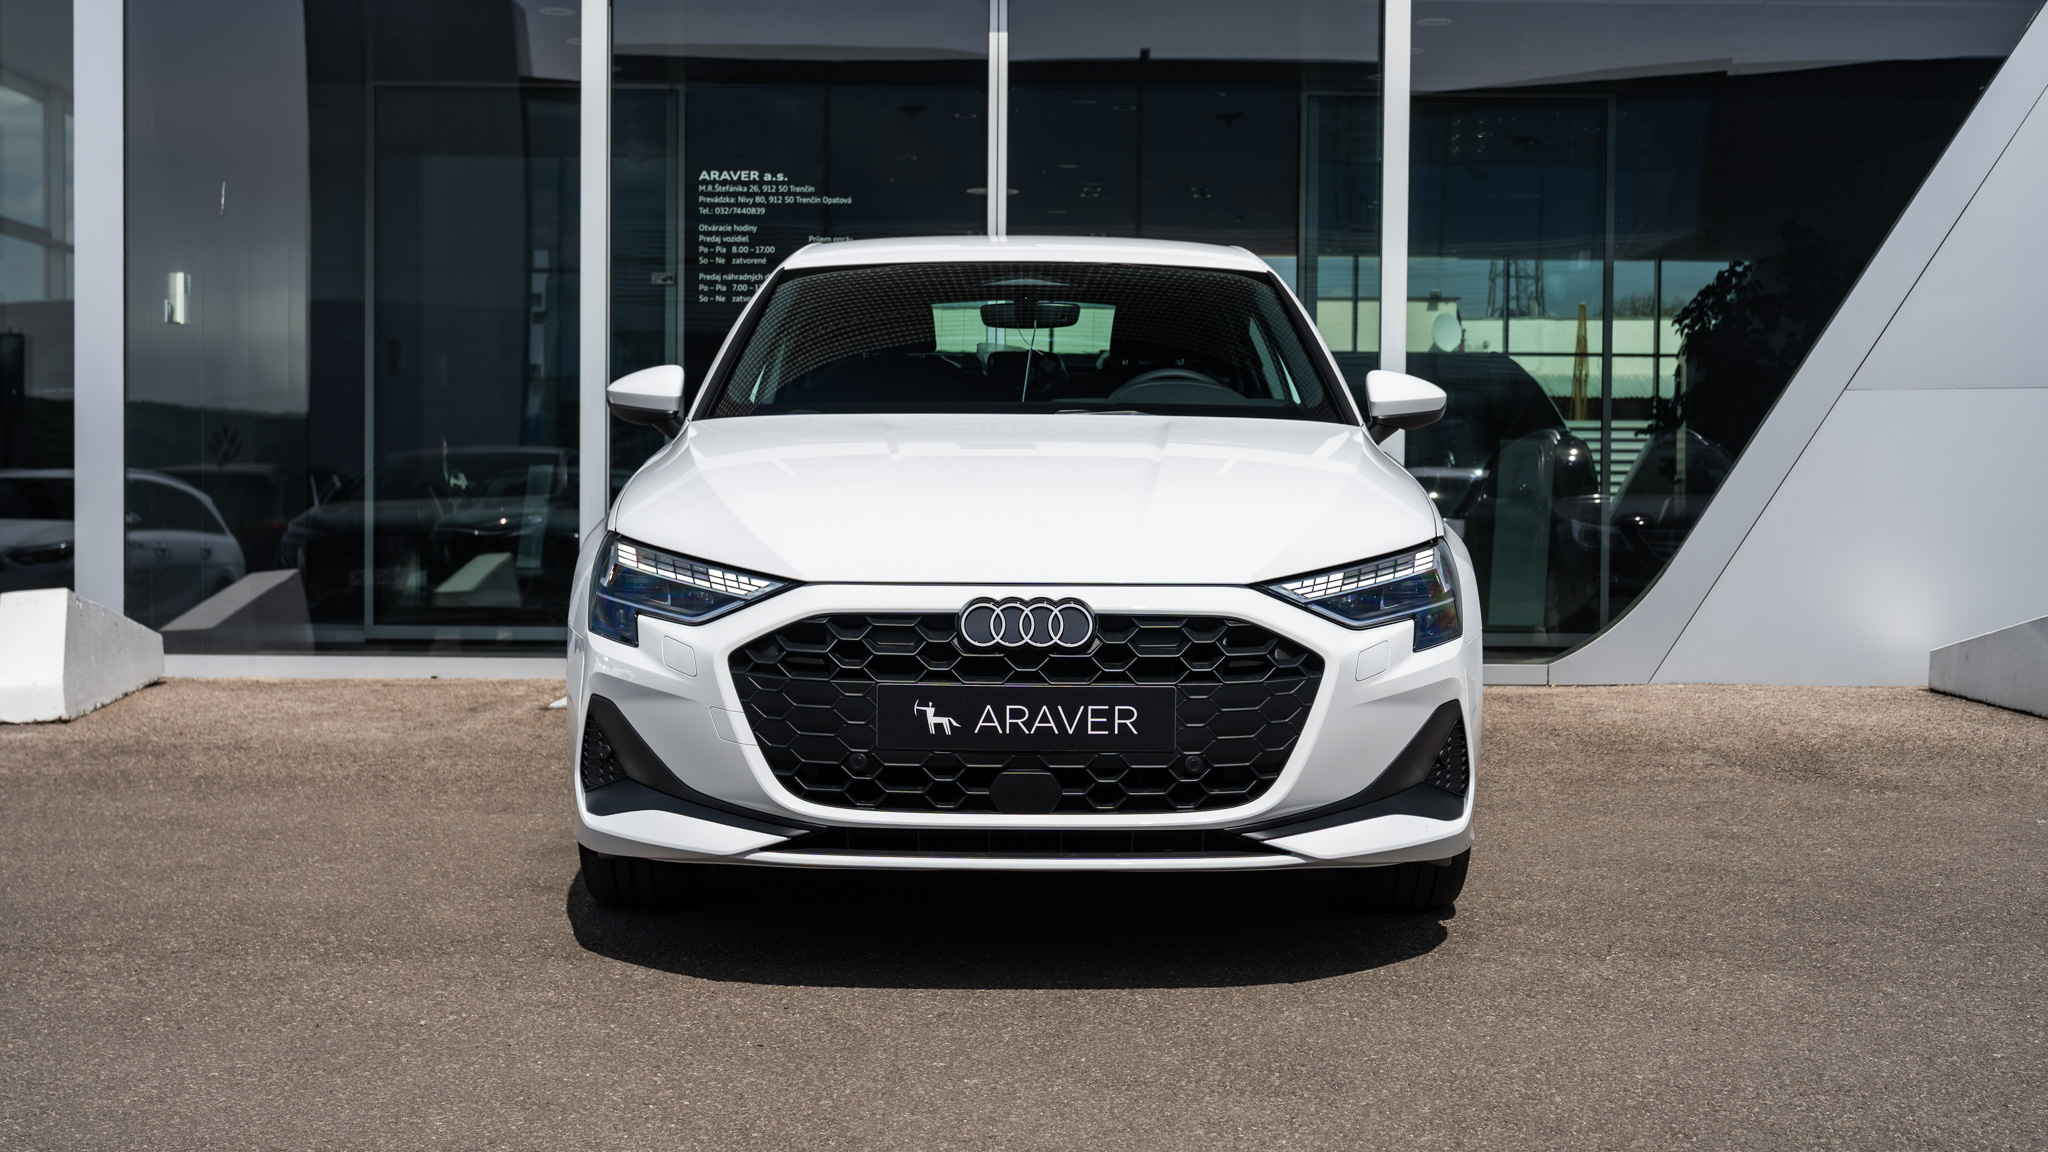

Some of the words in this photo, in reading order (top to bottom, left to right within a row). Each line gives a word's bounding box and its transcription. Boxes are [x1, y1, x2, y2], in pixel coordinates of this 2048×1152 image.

[699, 170, 759, 181] ARAVER
[764, 172, 788, 181] a.s.
[699, 183, 747, 192] M.R.Štefánika
[738, 196, 753, 205] Nivy
[796, 195, 821, 203] Trenčín
[823, 196, 852, 205] Opatová
[715, 207, 765, 215] 032/7440839
[734, 224, 758, 233] hodiny
[699, 235, 721, 244] Predaj
[699, 273, 721, 282] Predaj
[722, 273, 763, 282] náhradných
[974, 705, 1138, 734] ARAVER
